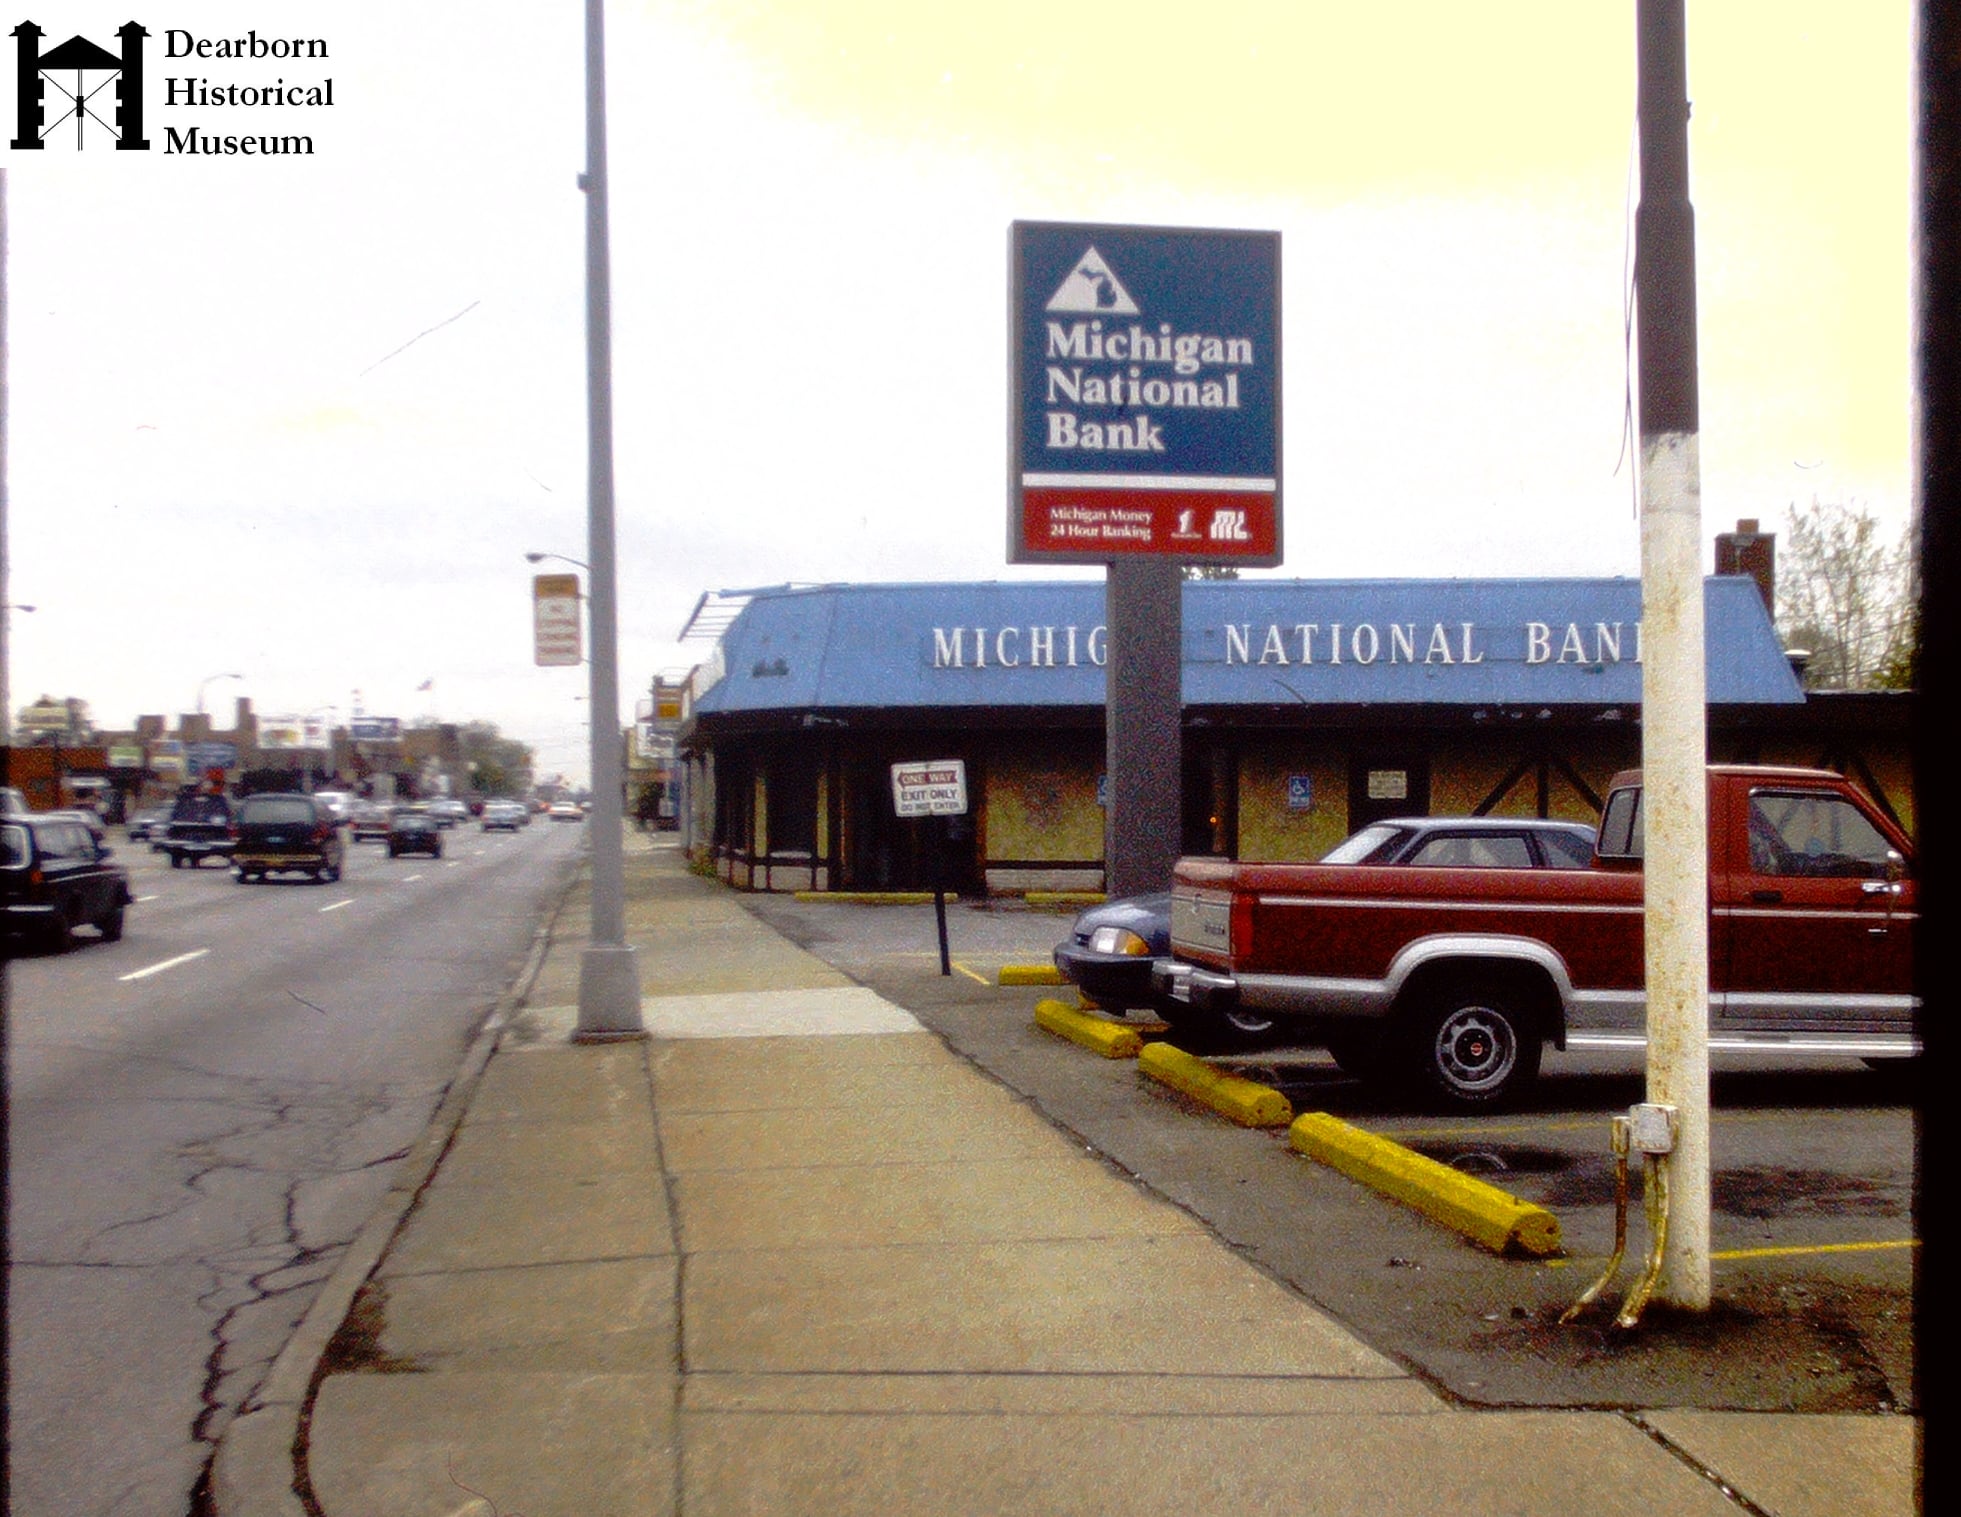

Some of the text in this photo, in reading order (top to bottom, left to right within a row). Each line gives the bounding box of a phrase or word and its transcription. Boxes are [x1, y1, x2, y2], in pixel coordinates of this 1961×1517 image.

[1045, 320, 1254, 375] Michigan
[1046, 366, 1240, 409] National
[1046, 412, 1166, 451] Bank
[1050, 507, 1153, 524] Michigan Money
[1050, 524, 1152, 541] 24 Hour Banking
[932, 626, 1108, 668] MICHIG
[1224, 622, 1485, 666] NATIONAL
[902, 772, 953, 785] ONE WAY
[901, 789, 958, 801] EXIT ONLY
